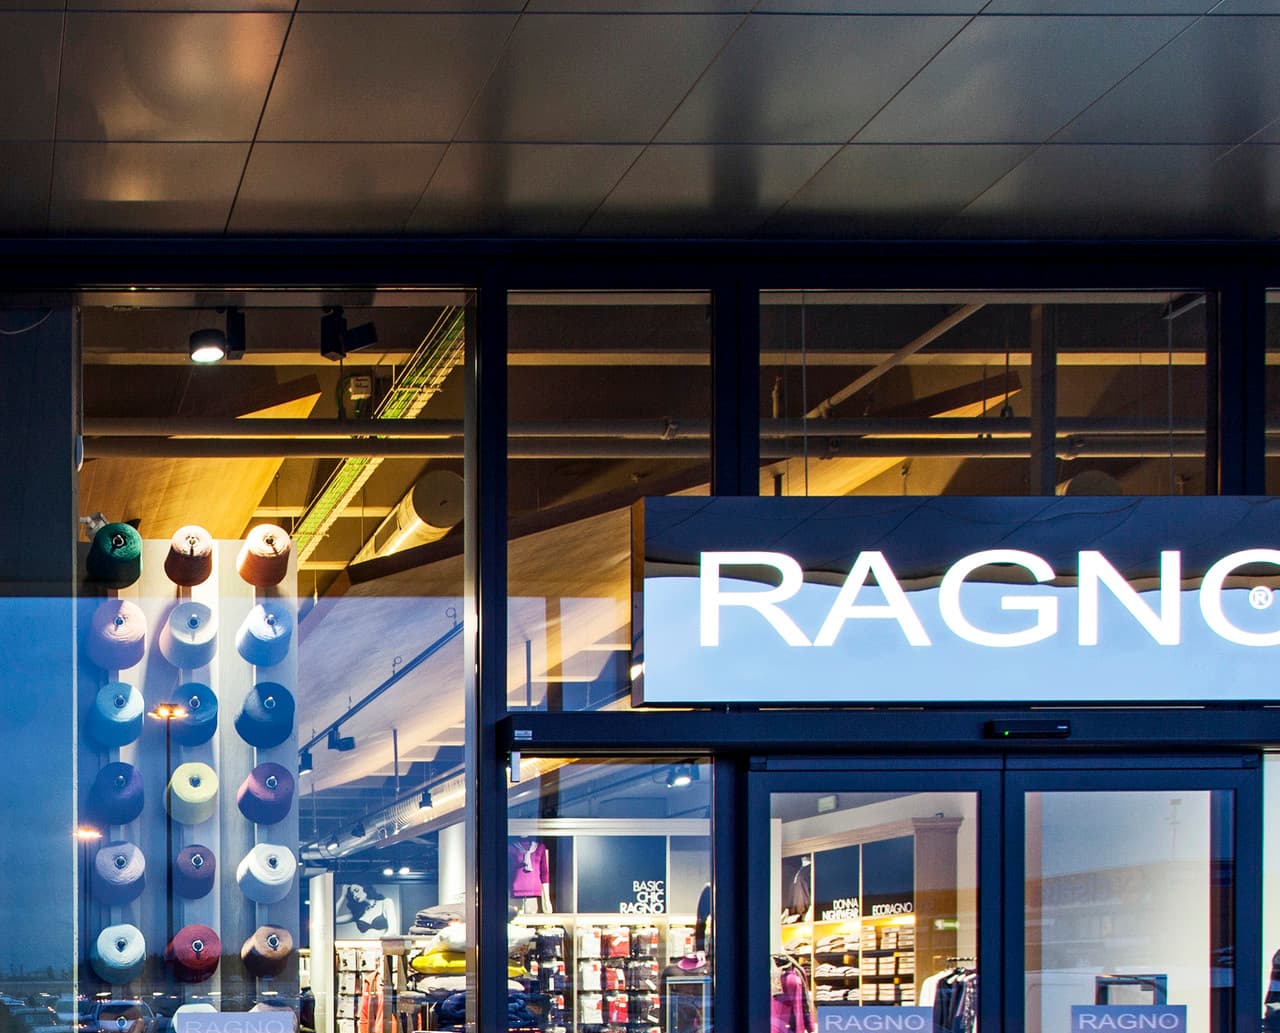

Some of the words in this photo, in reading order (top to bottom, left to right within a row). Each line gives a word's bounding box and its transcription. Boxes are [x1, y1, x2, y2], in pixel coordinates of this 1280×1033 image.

[632, 880, 665, 892] BASIC
[636, 891, 665, 903] CHIC
[832, 897, 859, 911] DONNA
[619, 902, 665, 914] RAGNO
[872, 902, 913, 917] ECORAGNO
[825, 1014, 925, 1031] RAGNO
[1079, 1013, 1179, 1030] RAGNO
